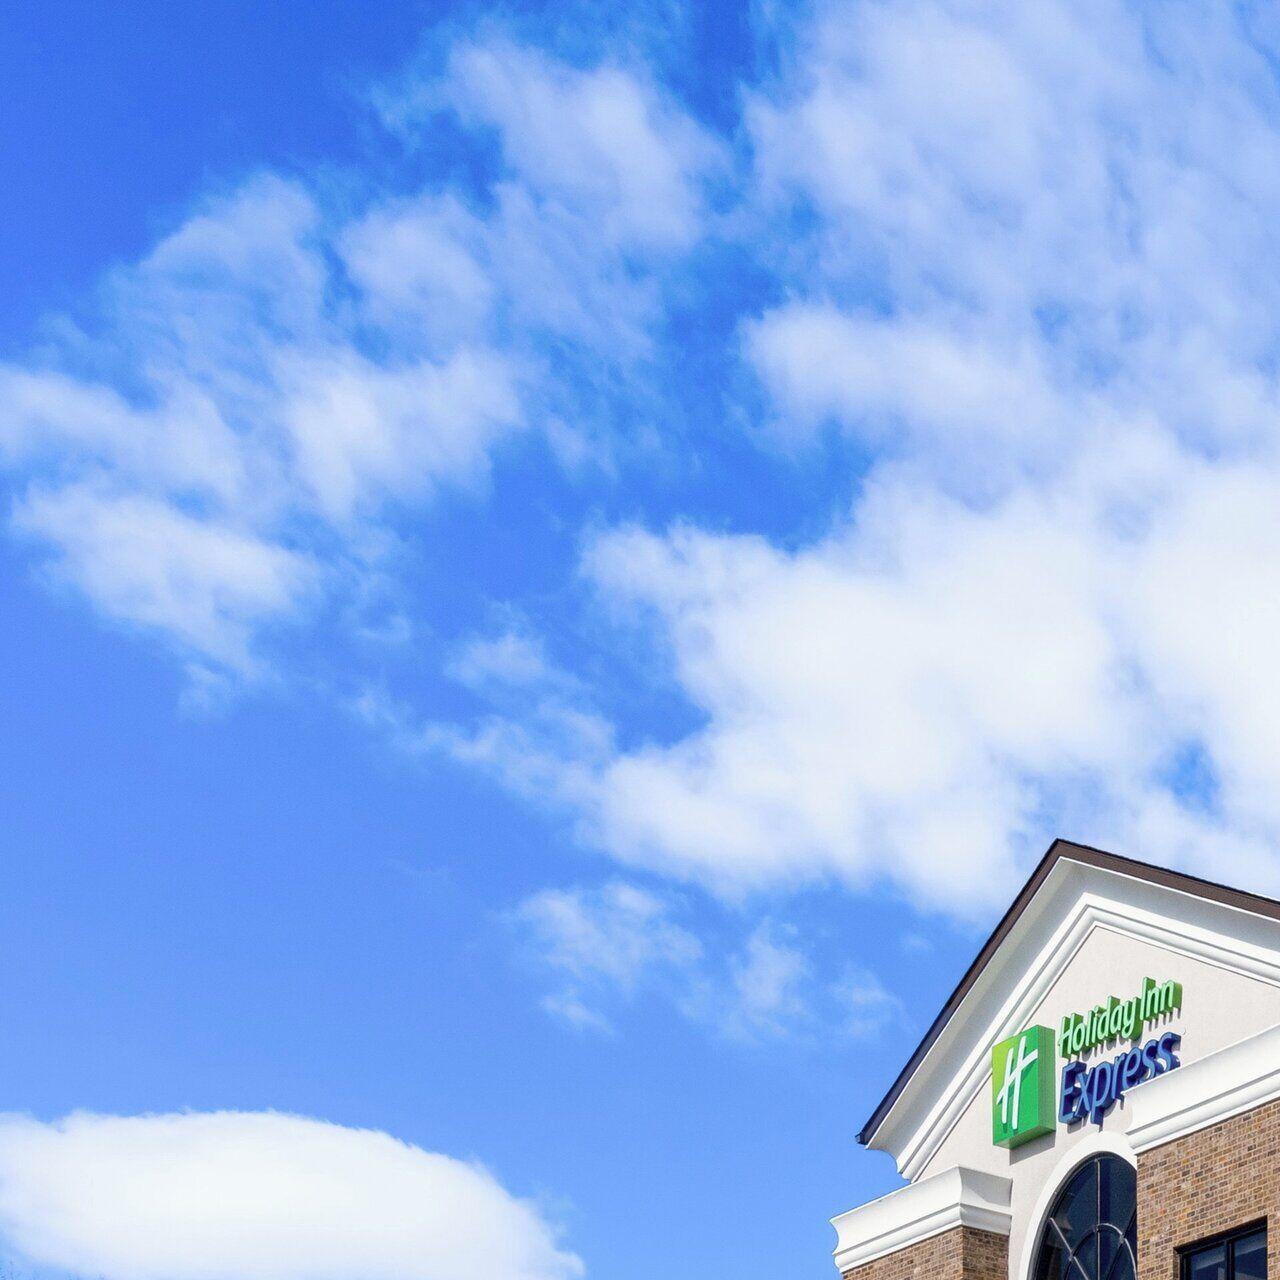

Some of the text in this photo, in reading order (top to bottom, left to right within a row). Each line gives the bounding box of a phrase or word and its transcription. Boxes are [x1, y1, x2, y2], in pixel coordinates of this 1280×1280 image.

[1058, 976, 1181, 1058] Holiday Inn
[1058, 1031, 1181, 1125] Express
